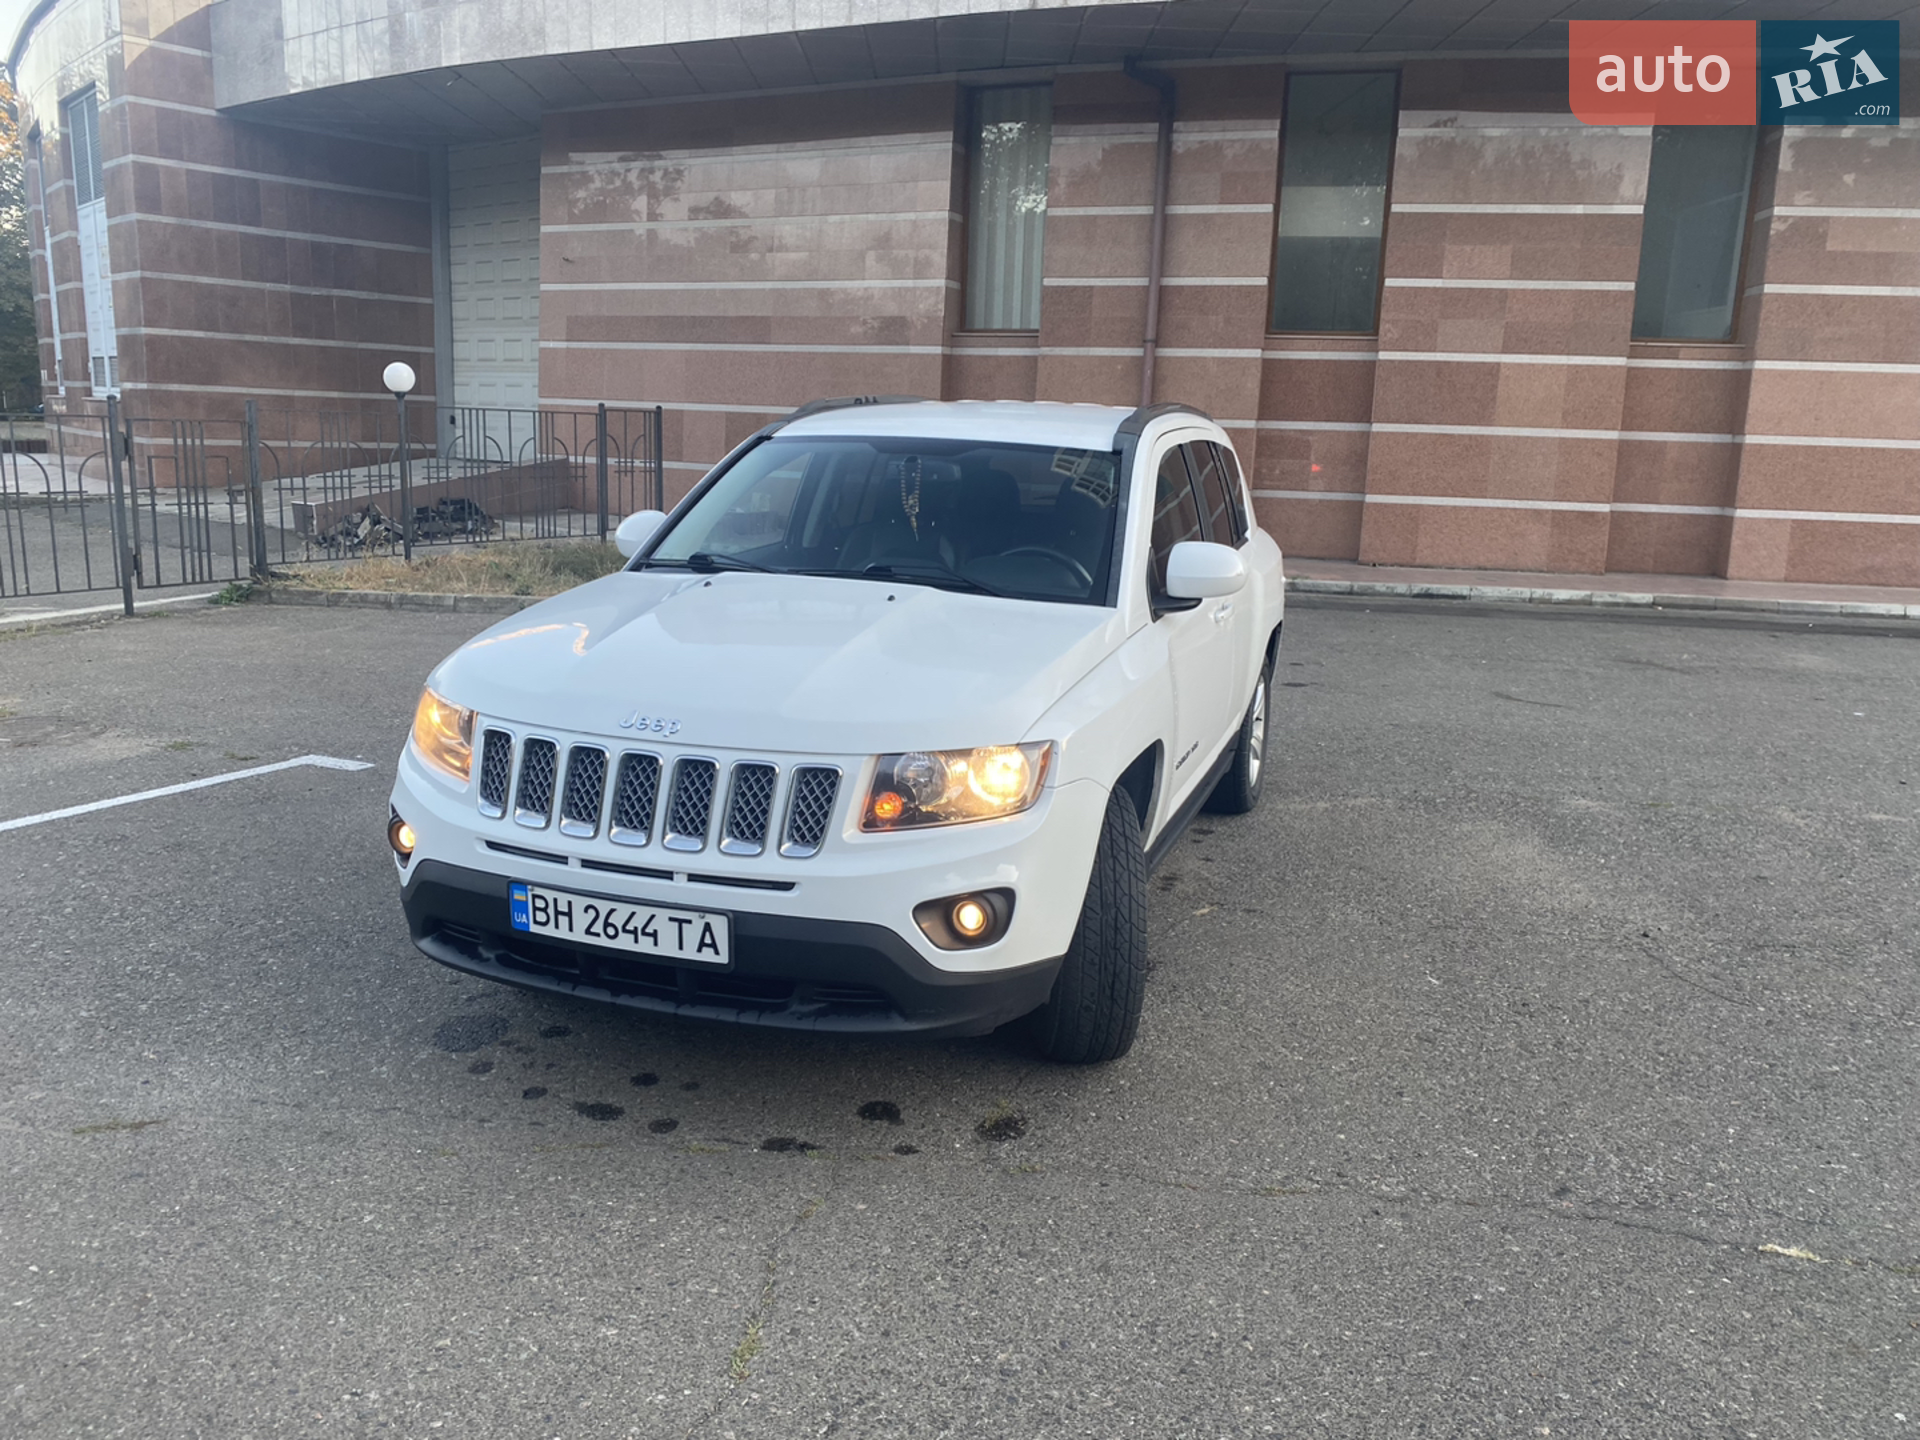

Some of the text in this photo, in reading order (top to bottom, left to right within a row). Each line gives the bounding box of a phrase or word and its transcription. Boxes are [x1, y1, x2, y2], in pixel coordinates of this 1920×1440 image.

[619, 710, 682, 737] Jeep
[514, 911, 528, 924] UA
[531, 893, 721, 956] BH 2644 TA
